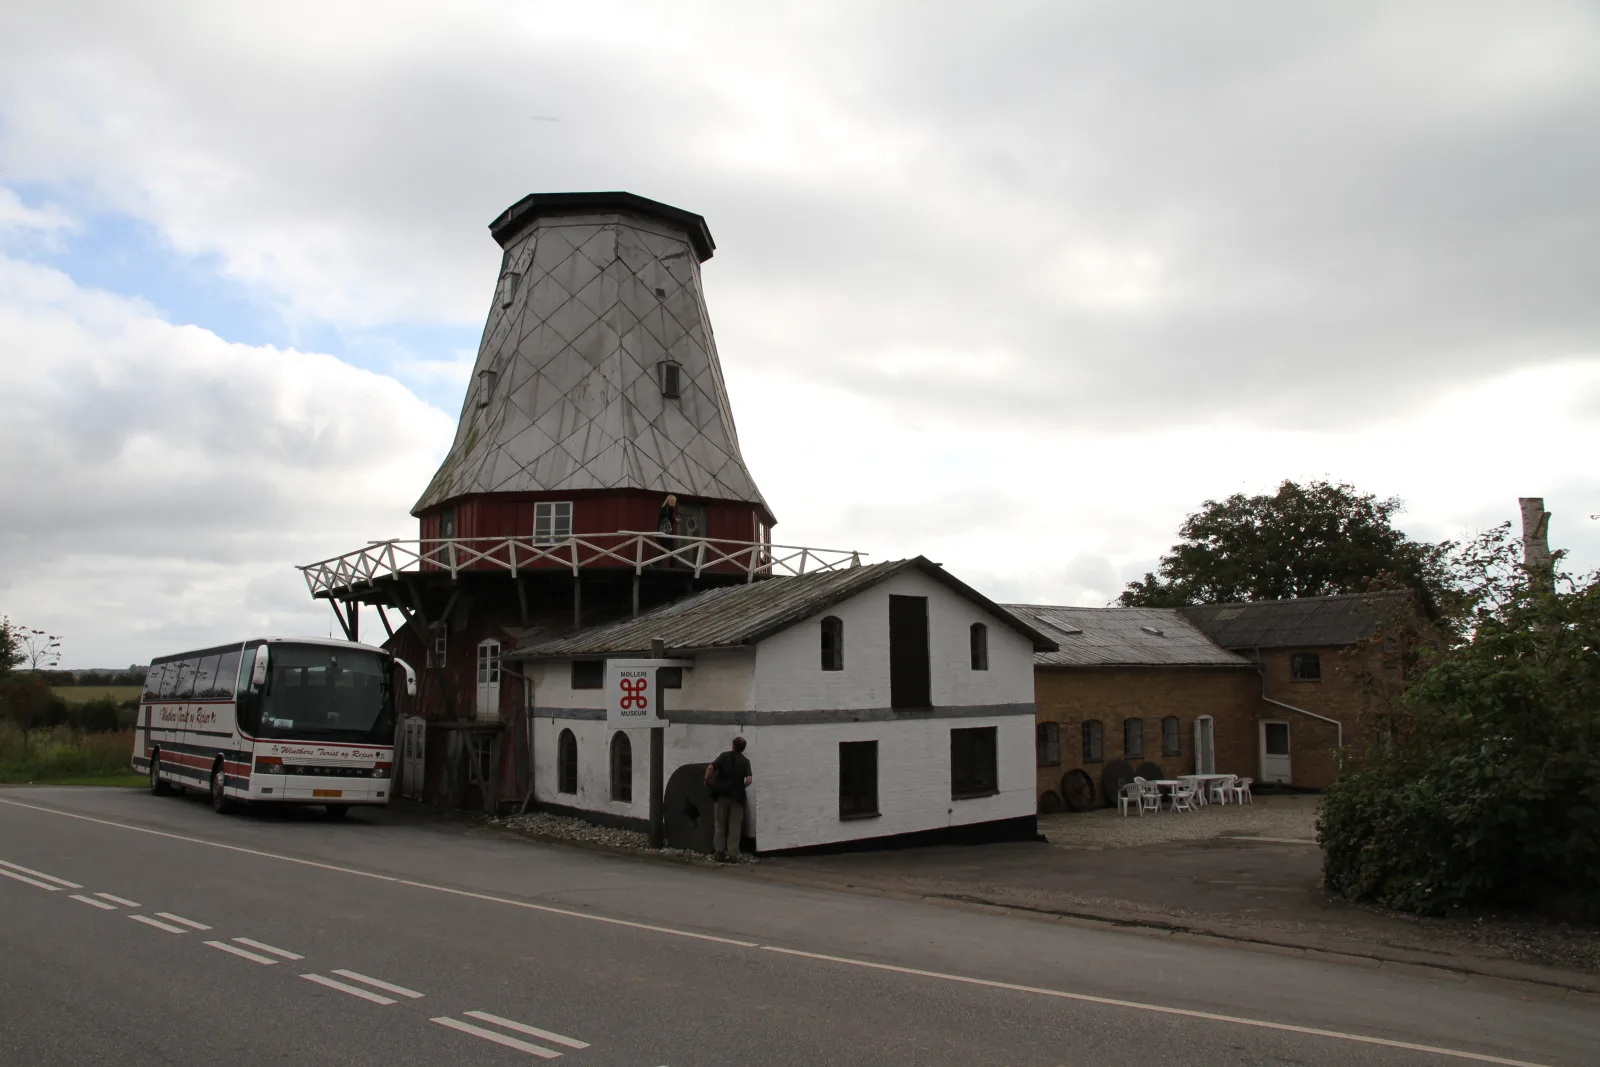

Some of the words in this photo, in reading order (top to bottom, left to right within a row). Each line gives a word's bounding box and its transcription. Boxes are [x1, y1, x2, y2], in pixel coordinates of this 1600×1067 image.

[280, 746, 313, 756] Winthers
[318, 748, 339, 757] Turist
[352, 750, 374, 759] Rejser
